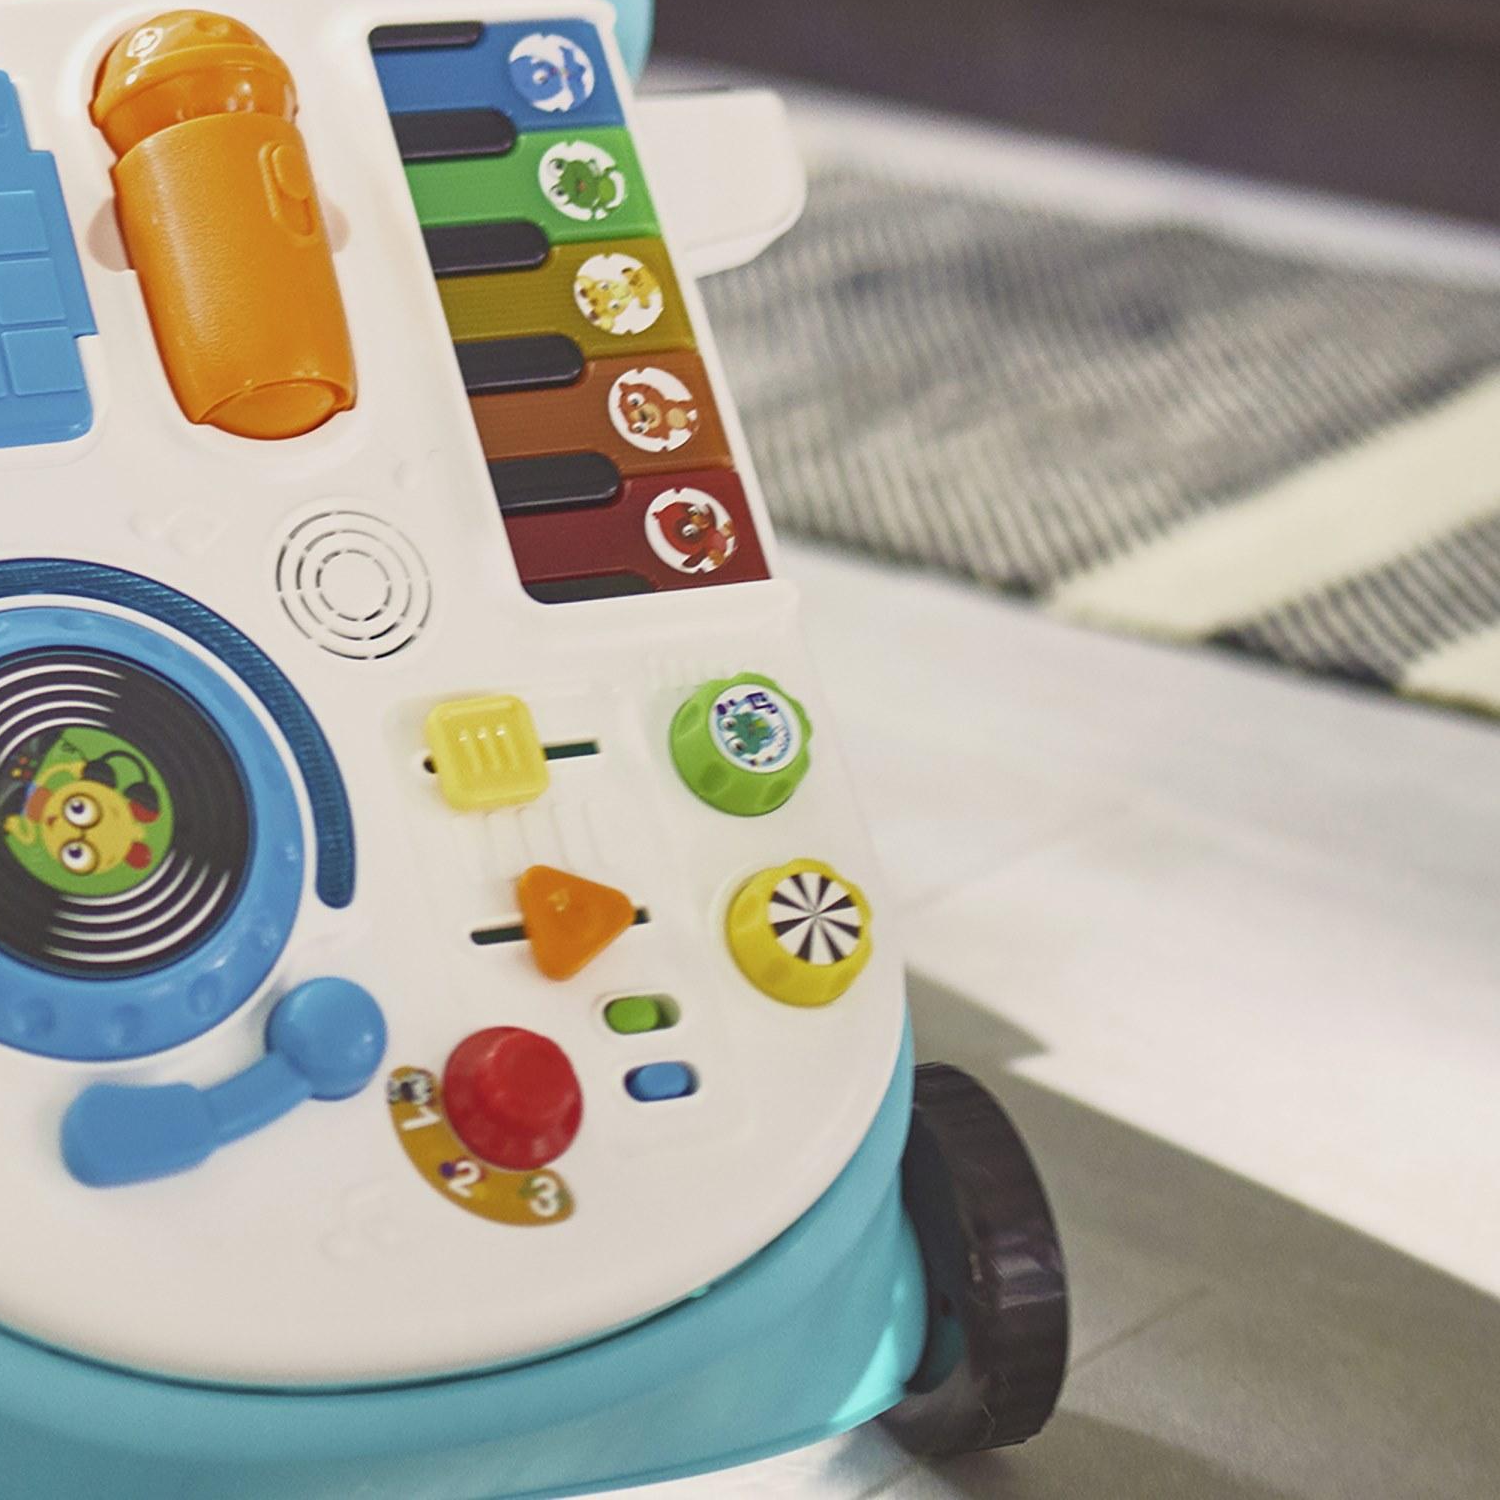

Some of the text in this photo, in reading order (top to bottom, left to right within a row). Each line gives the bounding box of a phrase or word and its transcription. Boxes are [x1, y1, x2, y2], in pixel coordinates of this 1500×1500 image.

[402, 1106, 441, 1131] 1
[450, 1160, 481, 1198] 2
[530, 1176, 559, 1217] 3
